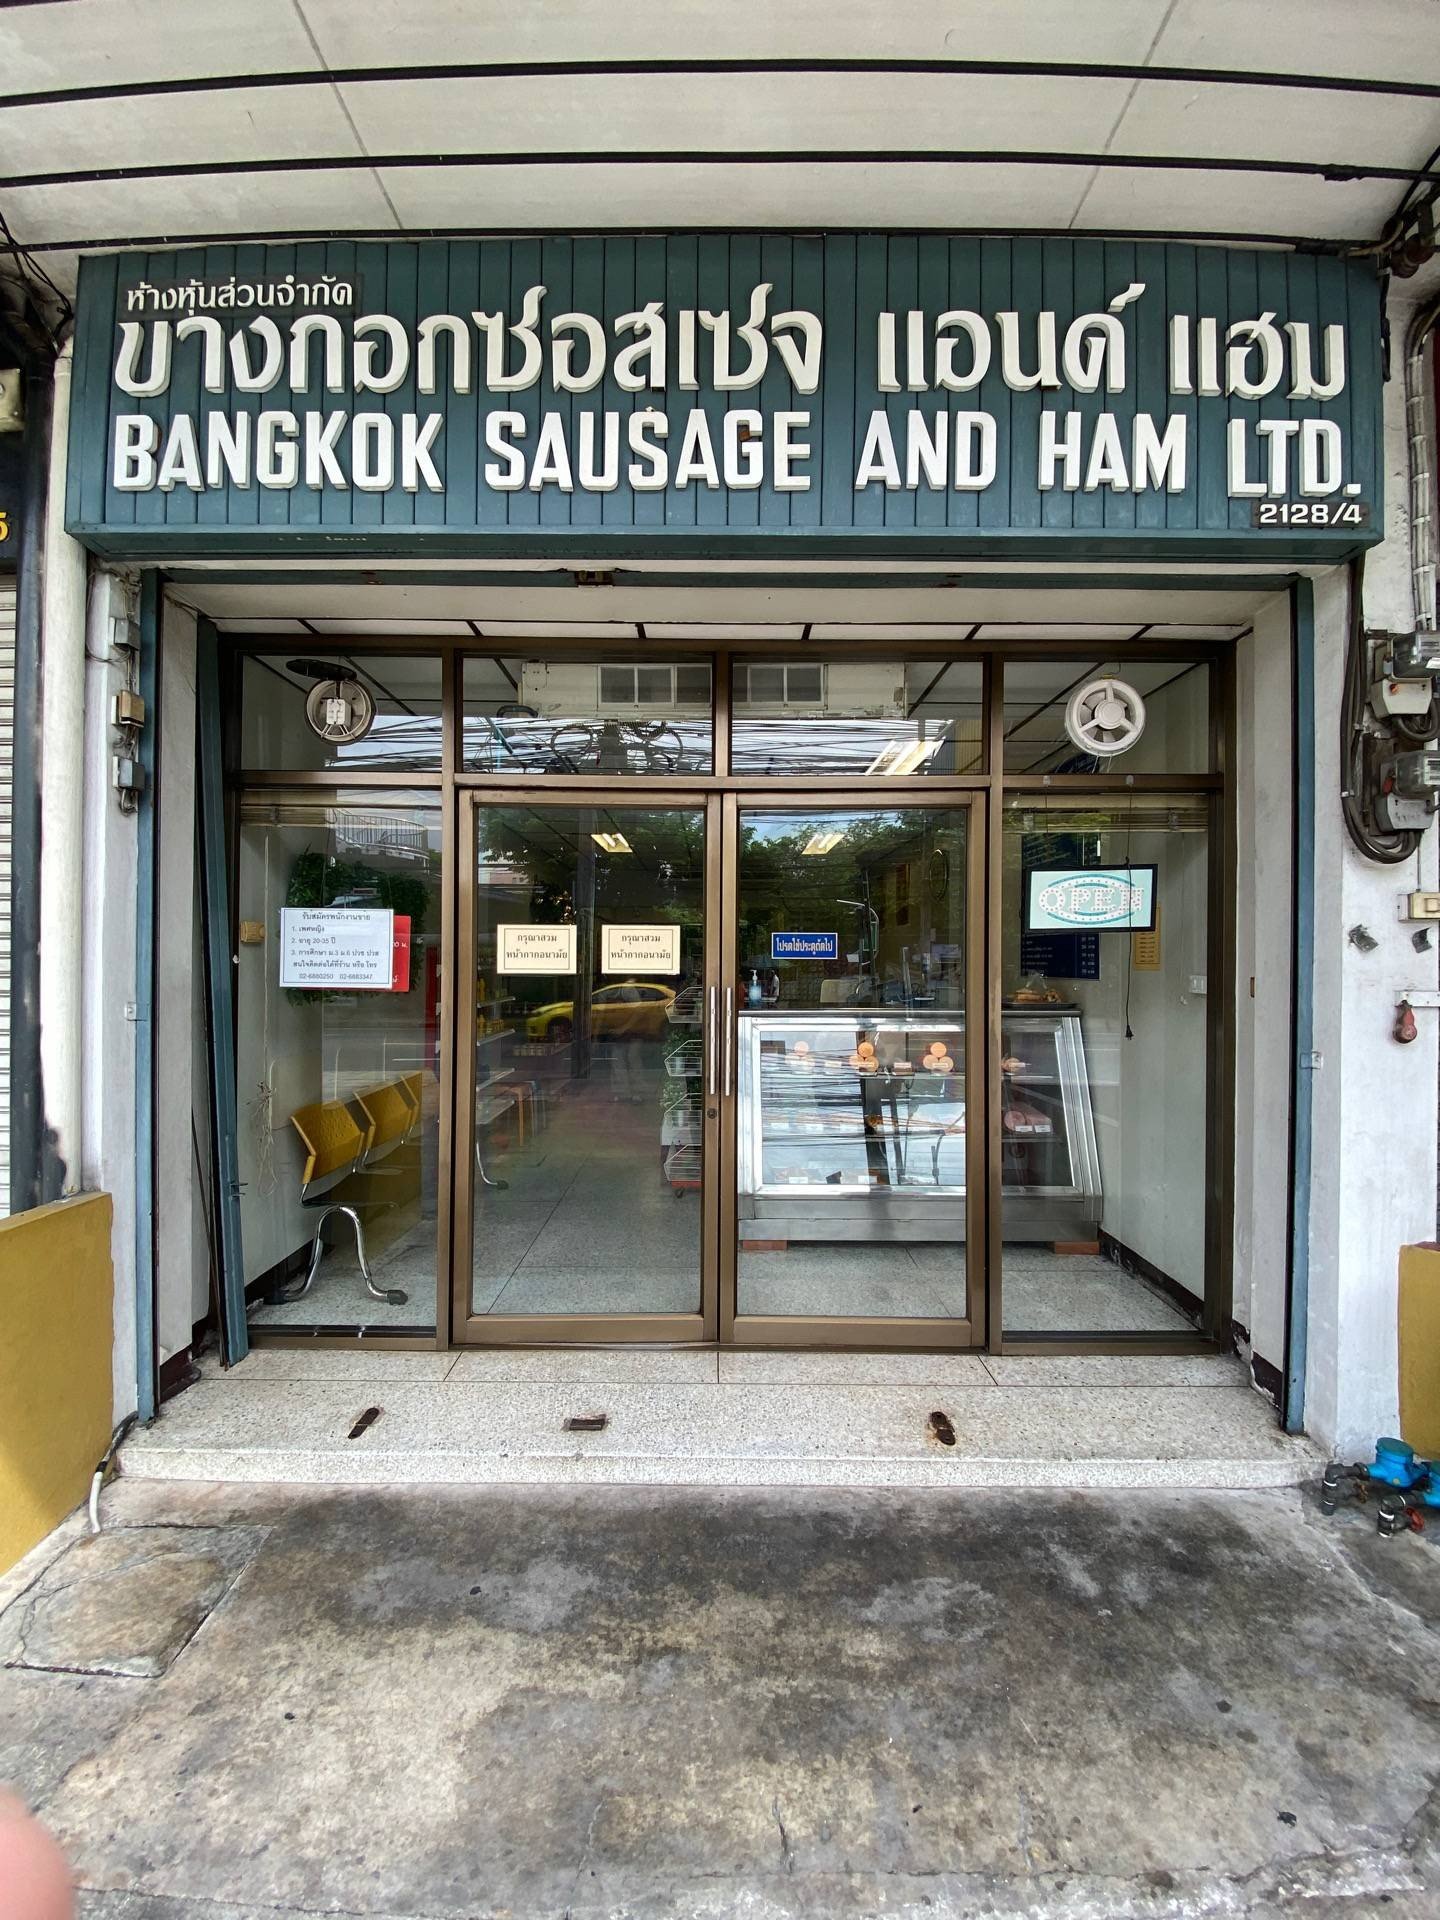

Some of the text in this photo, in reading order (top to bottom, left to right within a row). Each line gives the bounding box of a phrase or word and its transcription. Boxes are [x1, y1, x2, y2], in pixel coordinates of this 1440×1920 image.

[127, 274, 353, 317] ห้างหุ้นส่วนจำกัด
[877, 283, 1146, 394] แอนด์
[1169, 311, 1346, 400] แฮม
[113, 408, 1362, 499] BANGKOK SAUSAGE AND HAM LTD.
[1259, 502, 1363, 526] 2128/4
[1038, 887, 1145, 913] OPEN
[517, 934, 557, 945] กรุณาสวม
[621, 934, 661, 945] กรุณาสวม
